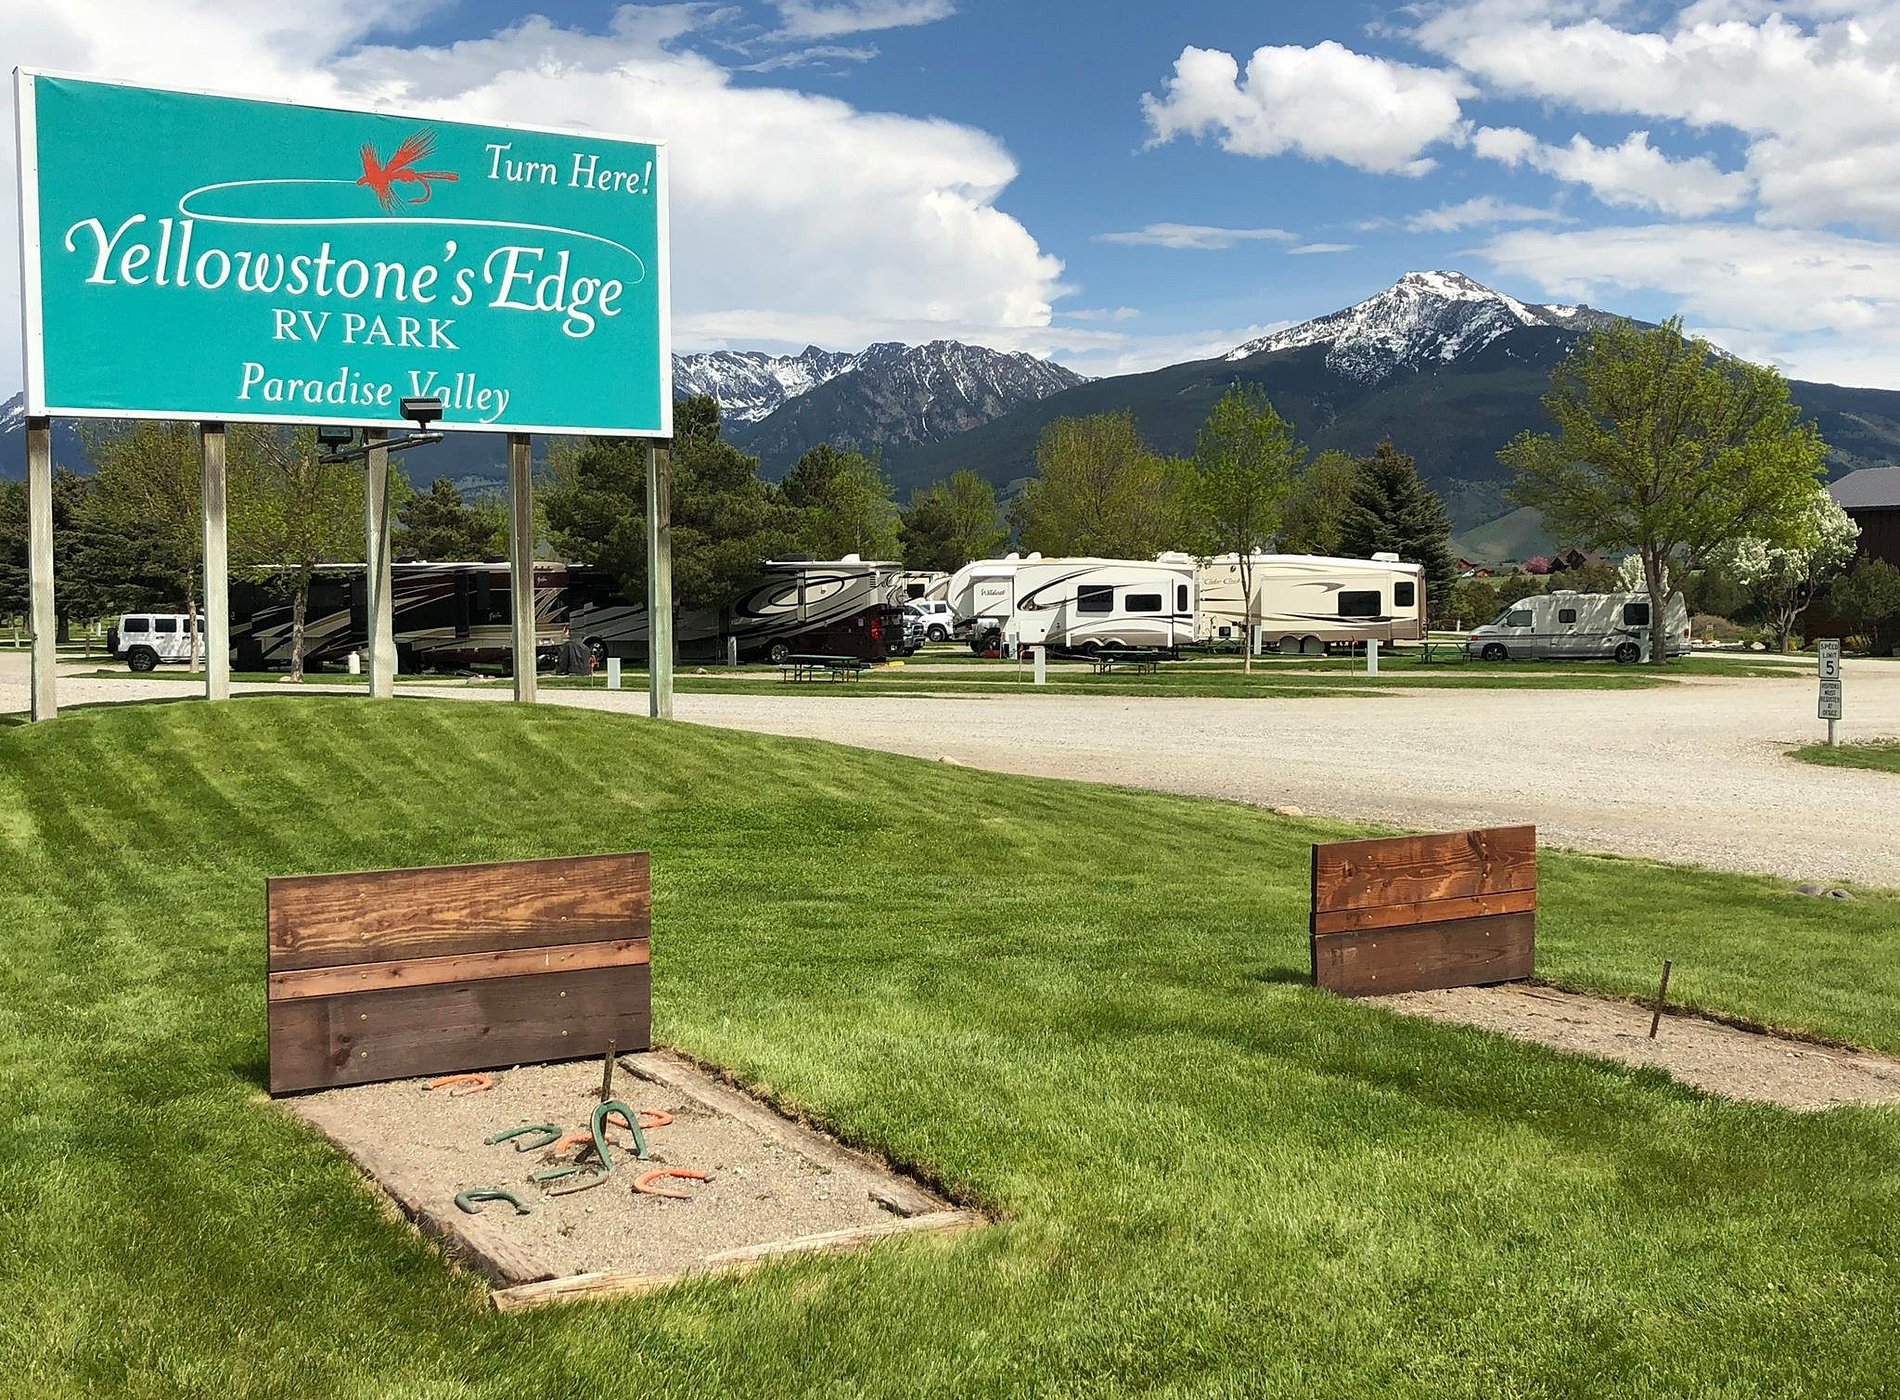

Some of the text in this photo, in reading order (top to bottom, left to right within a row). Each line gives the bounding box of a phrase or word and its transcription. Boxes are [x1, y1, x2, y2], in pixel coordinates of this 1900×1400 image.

[485, 142, 654, 195] Turn Here!
[64, 212, 624, 338] Yellowstone's Edge
[271, 308, 460, 350] RV PARK
[237, 362, 511, 425] Paradise Valley
[1826, 660, 1834, 675] 5
